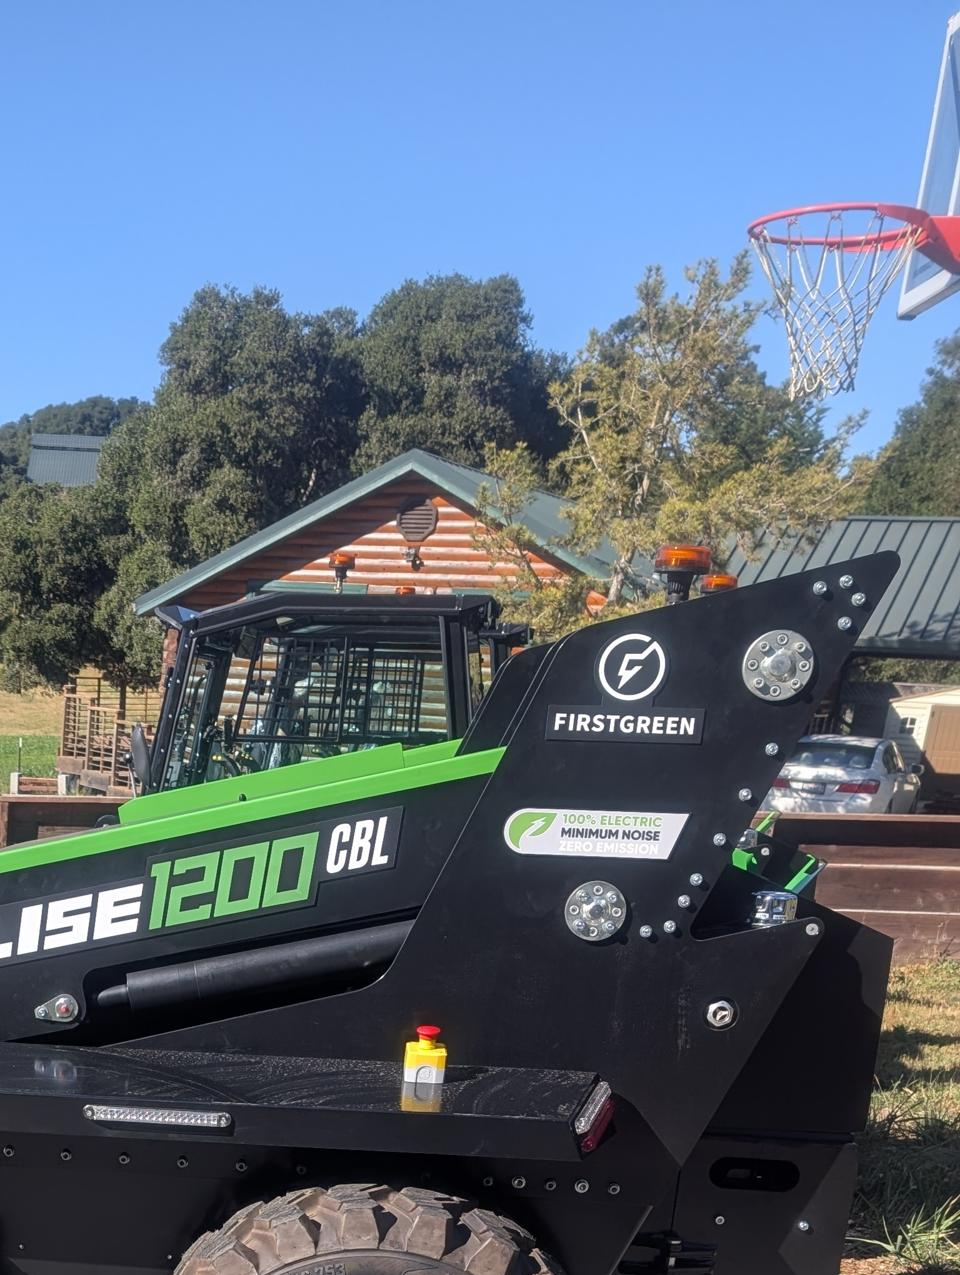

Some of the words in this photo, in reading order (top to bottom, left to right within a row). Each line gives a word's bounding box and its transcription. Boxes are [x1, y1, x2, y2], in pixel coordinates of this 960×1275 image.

[554, 713, 696, 736] FIRSTGREEN
[563, 814, 596, 825] 100%
[600, 816, 663, 827] ELECTRIC
[561, 827, 619, 840] MINIMUM
[622, 829, 661, 842] NOISE
[559, 840, 593, 853] ZERO
[597, 842, 659, 855] EMISSION
[149, 831, 320, 930] 1200
[326, 816, 389, 874] CBL
